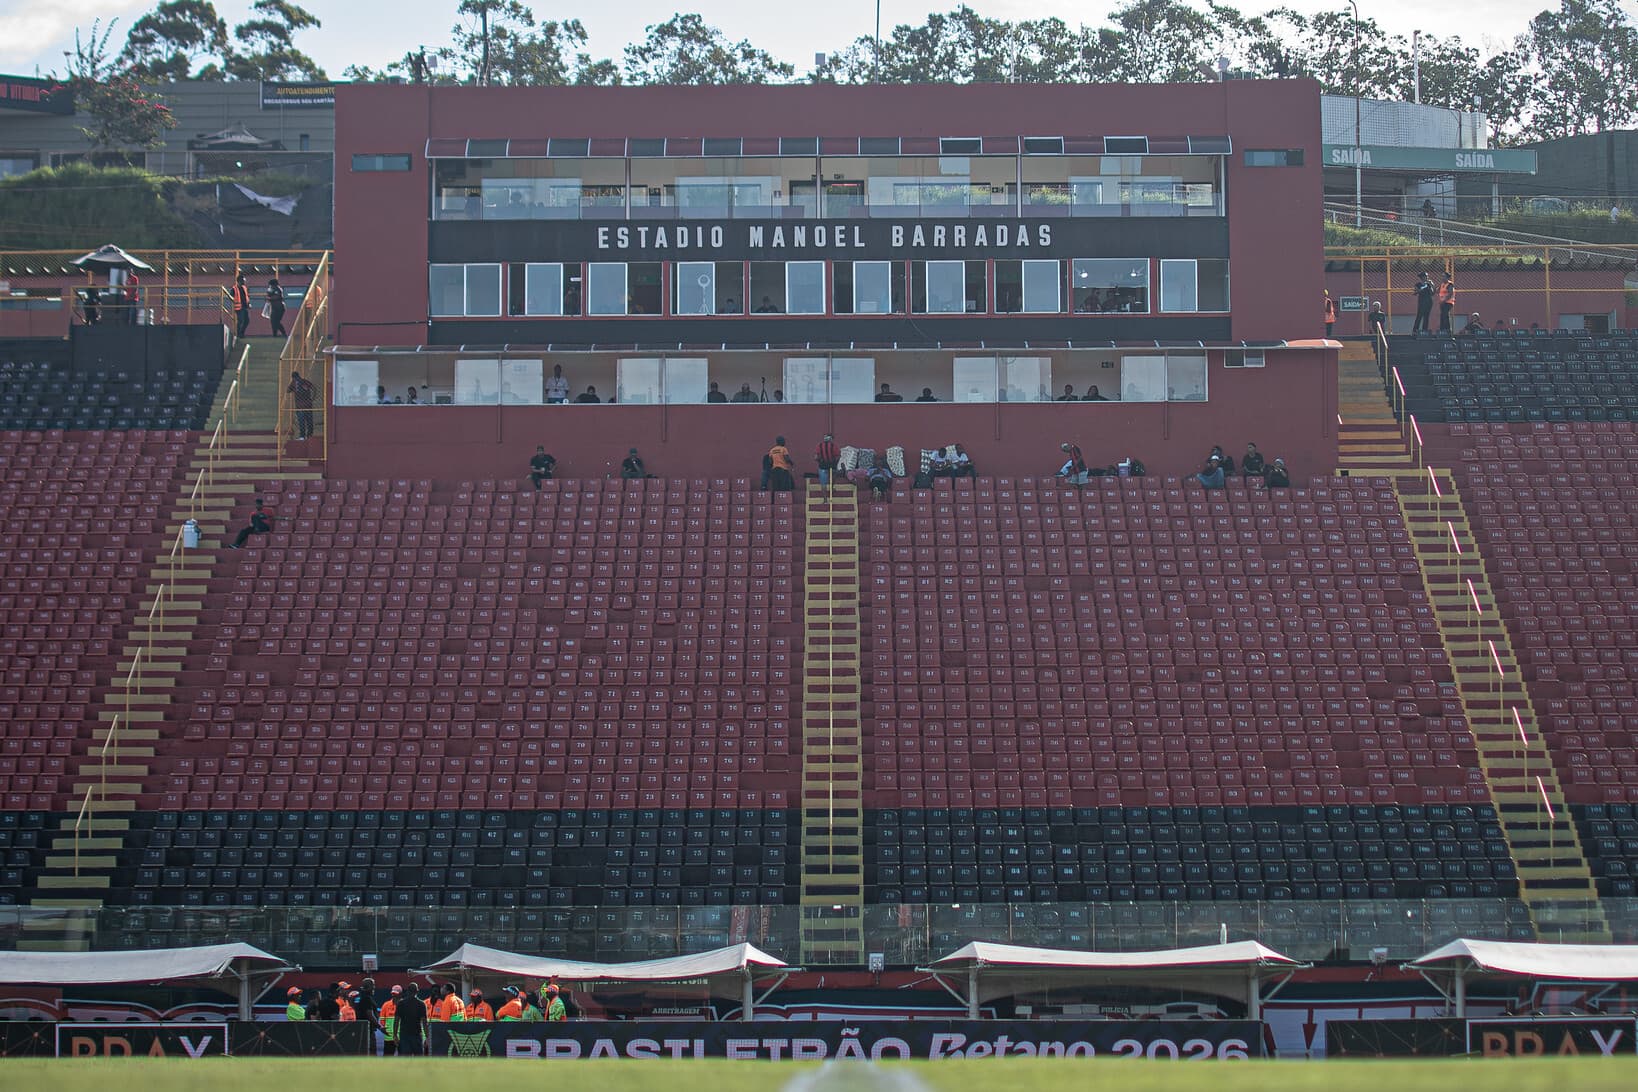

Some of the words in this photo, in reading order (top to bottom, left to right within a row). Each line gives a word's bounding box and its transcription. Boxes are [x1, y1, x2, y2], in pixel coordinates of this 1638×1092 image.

[1332, 147, 1372, 164] SAÍDA
[1455, 151, 1495, 169] SAÍDA
[598, 226, 723, 249] ESTADIO
[750, 225, 865, 248] MANOEL
[892, 224, 1051, 248] BARRADAS
[929, 1033, 1096, 1061] Betano
[1112, 1038, 1250, 1061] 2026
